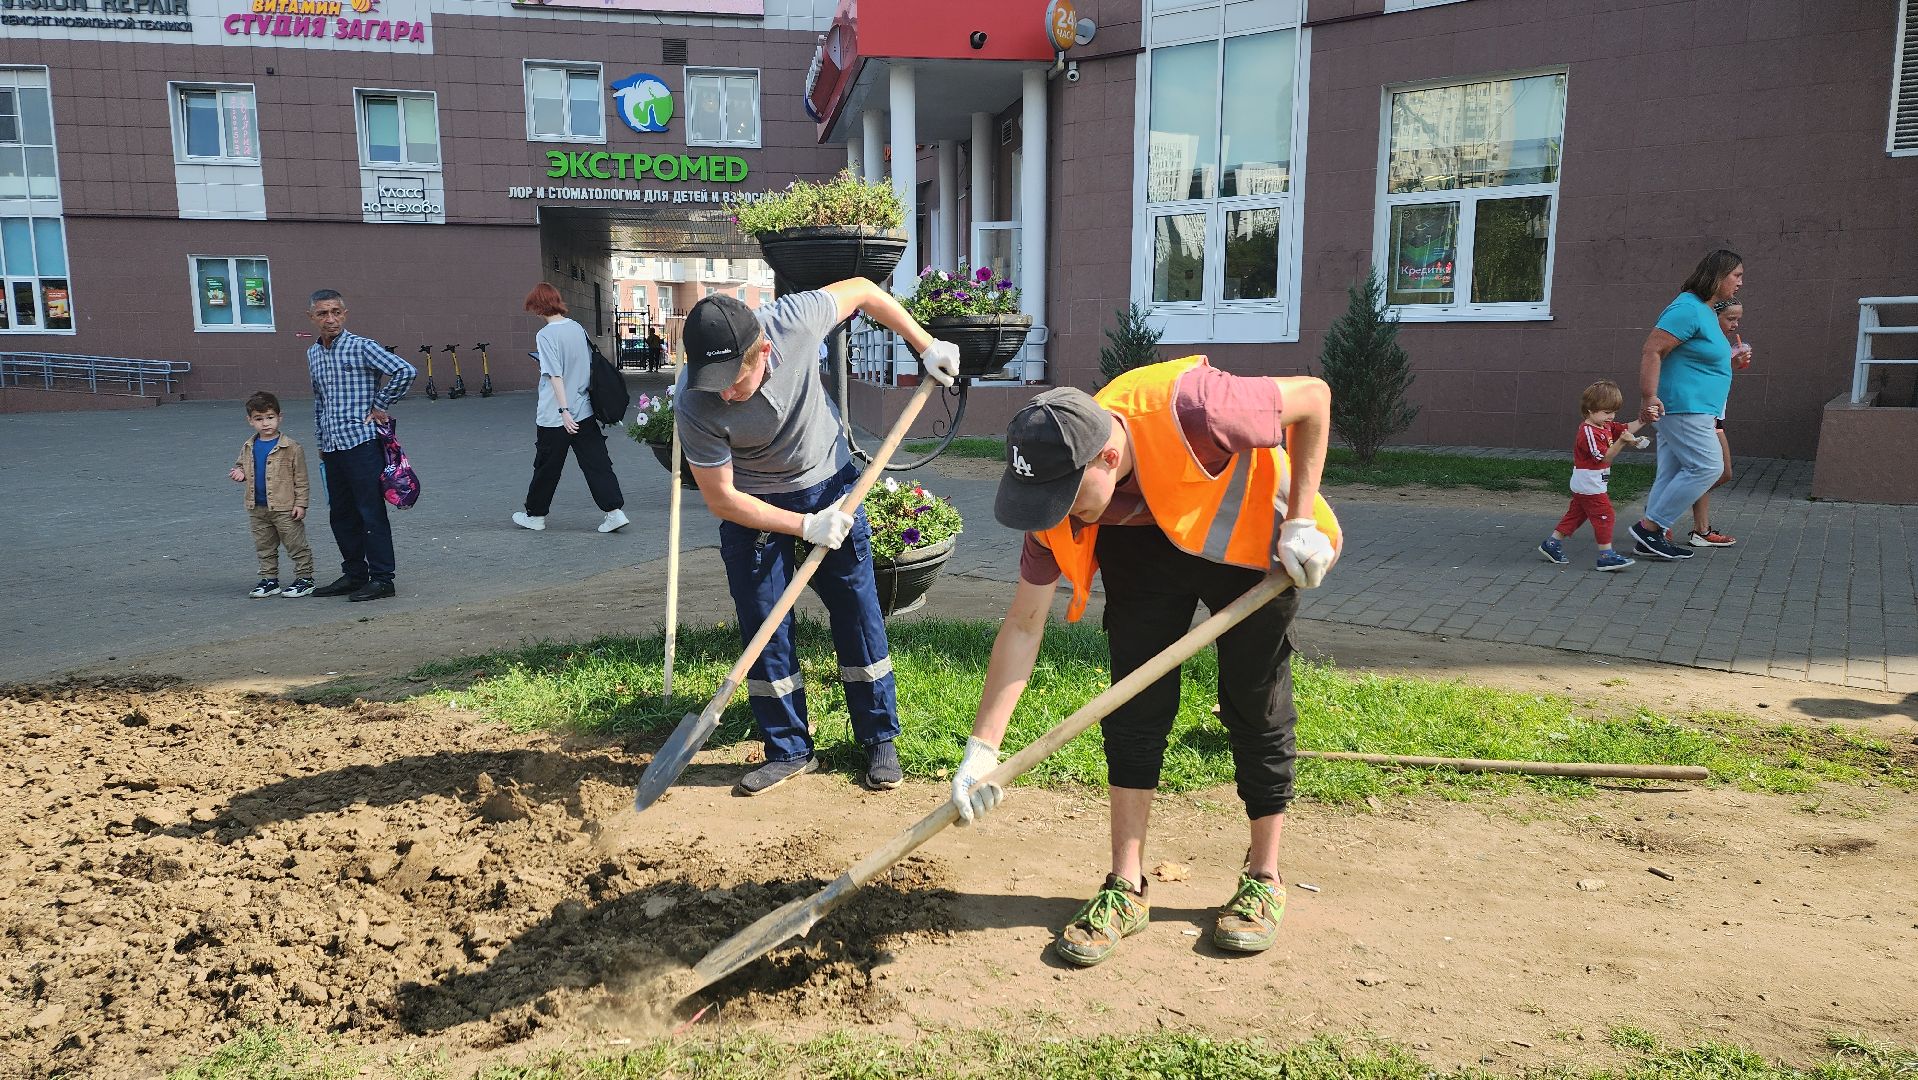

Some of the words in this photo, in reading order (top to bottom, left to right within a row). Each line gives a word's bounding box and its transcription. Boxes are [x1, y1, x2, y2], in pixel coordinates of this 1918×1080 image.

[252, 0, 341, 16] ВИТАМИН
[1, 15, 51, 26] РЕМОНТ
[53, 16, 135, 29] МОБИЛЬНОЙ
[138, 20, 193, 32] ТЕХНИКИ
[1057, 7, 1075, 29] 24
[224, 14, 326, 38] СТУДИЯ
[334, 18, 425, 42] ЗАГАРА
[379, 184, 423, 198] Класс
[508, 186, 533, 198] ЛОР
[536, 186, 545, 199] И
[548, 186, 641, 201] СТОМАТОЛОГИЯ
[644, 189, 669, 203] ДЛЯ
[673, 188, 708, 204] ДЕТЕЙ
[711, 191, 720, 203] И
[362, 202, 381, 212] на
[387, 200, 441, 213] Чехова
[1012, 445, 1035, 477] LA
